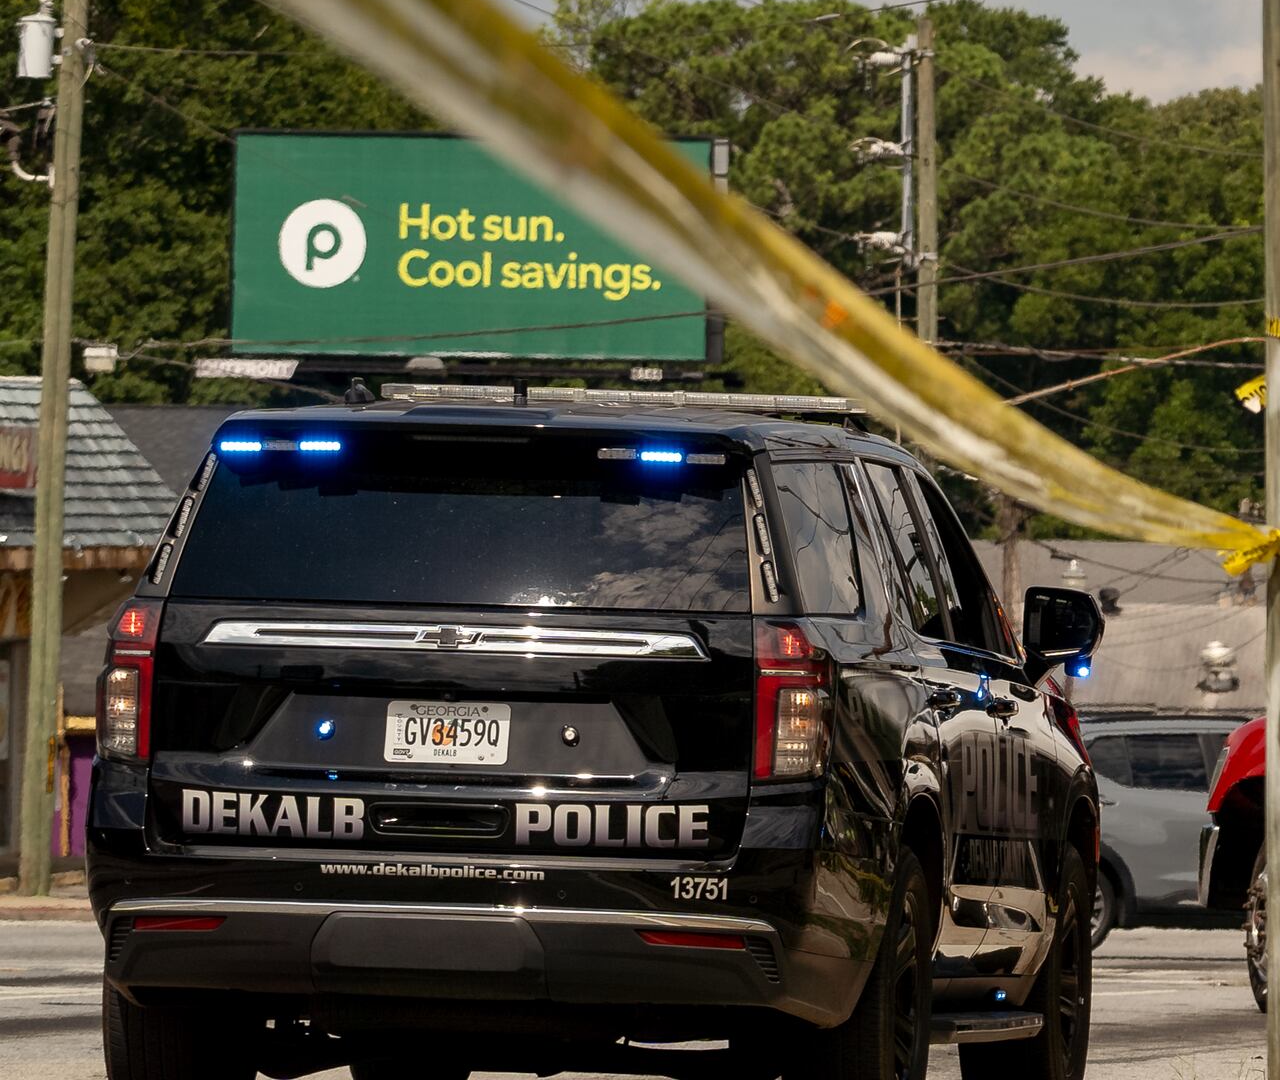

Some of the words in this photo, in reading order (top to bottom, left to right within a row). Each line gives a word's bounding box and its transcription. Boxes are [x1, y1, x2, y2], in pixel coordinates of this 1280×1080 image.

[398, 203, 476, 241] Hot
[482, 214, 565, 242] sun.
[398, 248, 492, 288] Cool
[501, 252, 662, 301] savings.
[415, 704, 481, 718] GEORGIA
[404, 717, 500, 748] GV3459Q
[433, 748, 457, 757] DEKALB
[960, 732, 1039, 831] POLICE
[182, 789, 365, 842] DEKALB
[514, 802, 709, 849] POLICE
[320, 863, 545, 881] www.dekalbpolice.com
[670, 876, 728, 901] 13751
